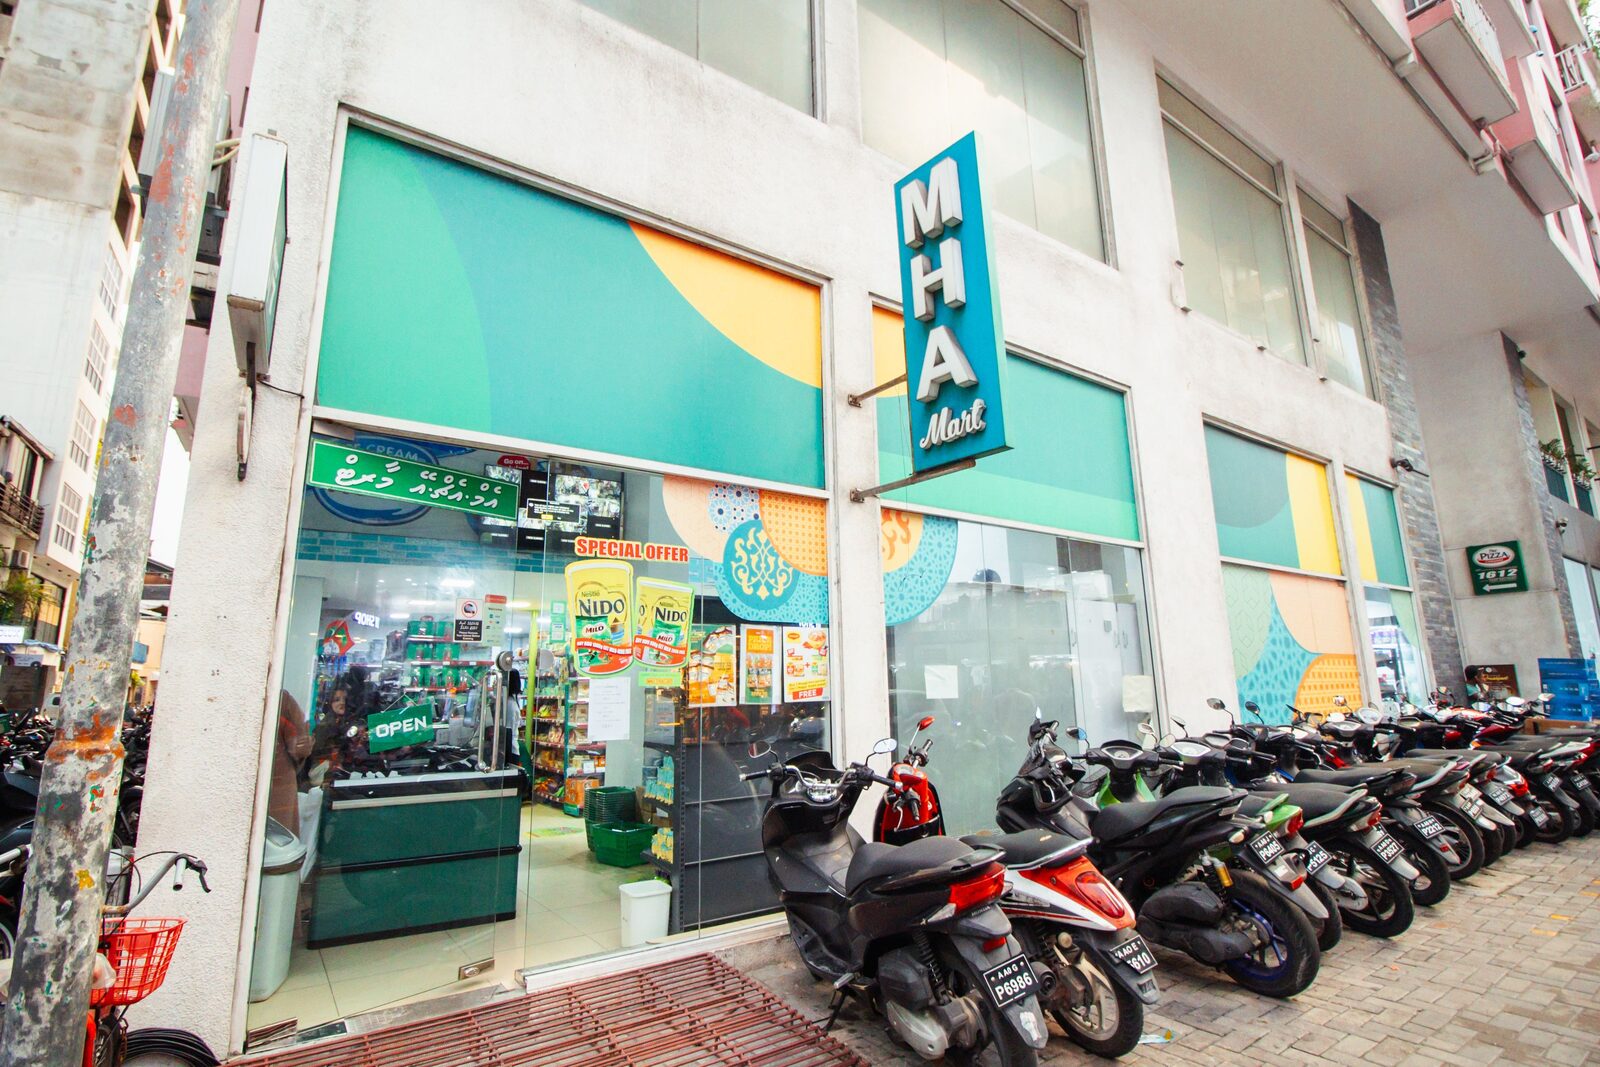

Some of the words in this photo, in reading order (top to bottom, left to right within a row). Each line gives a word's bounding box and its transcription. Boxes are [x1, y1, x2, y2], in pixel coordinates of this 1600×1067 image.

[900, 156, 978, 403] MHA
[919, 398, 986, 450] Mart
[576, 538, 642, 559] SPECIAL
[646, 545, 689, 562] OFFER
[1479, 551, 1508, 560] PIZZA
[1477, 568, 1518, 580] 1612
[579, 598, 625, 617] NIDO
[655, 607, 687, 622] NIDO
[585, 625, 604, 634] MILO
[657, 635, 673, 643] MILO
[799, 690, 817, 699] FREE
[376, 716, 427, 738] OPEN
[1421, 823, 1442, 836] P2212
[1259, 841, 1281, 861] P6405
[1380, 842, 1400, 860] P3527
[994, 972, 1032, 1000] P6986
